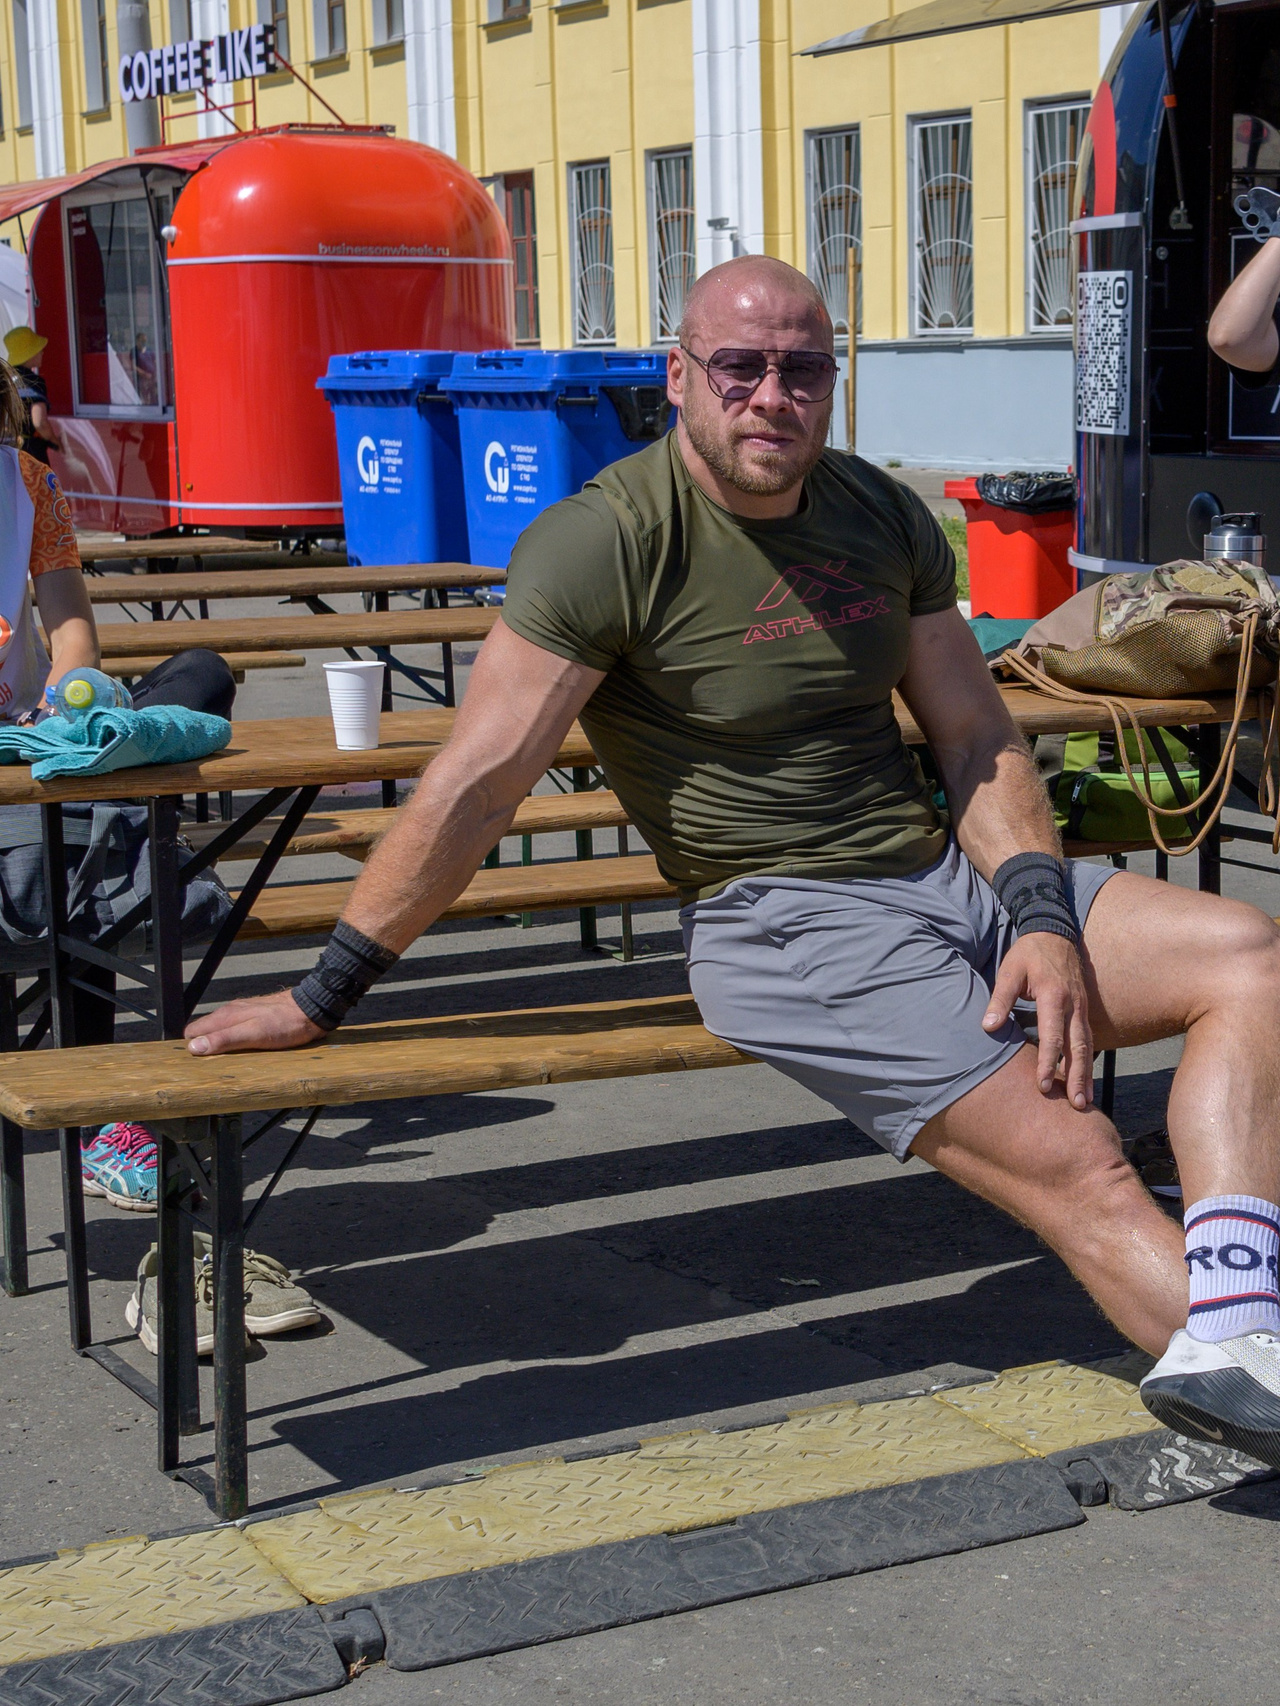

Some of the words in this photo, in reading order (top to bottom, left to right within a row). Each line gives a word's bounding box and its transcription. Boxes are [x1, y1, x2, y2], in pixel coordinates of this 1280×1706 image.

[119, 40, 204, 103] COFFEE
[214, 23, 267, 83] LIKE
[318, 242, 450, 256] businessonwheels.ru
[742, 595, 891, 645] ATHLEX
